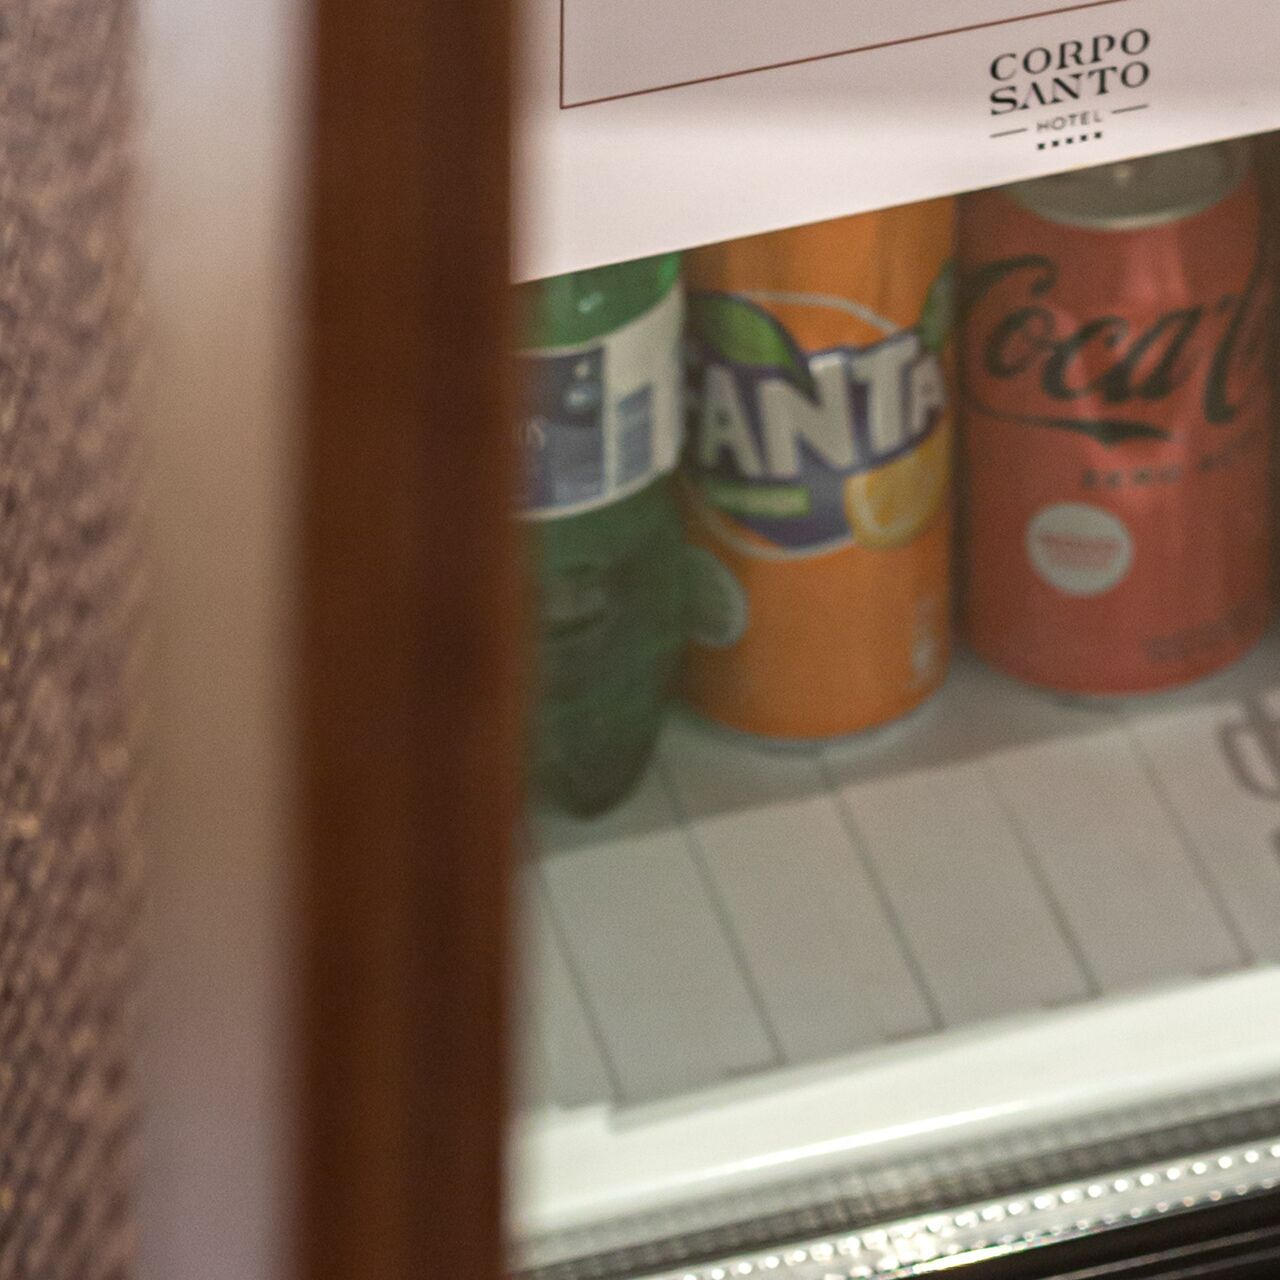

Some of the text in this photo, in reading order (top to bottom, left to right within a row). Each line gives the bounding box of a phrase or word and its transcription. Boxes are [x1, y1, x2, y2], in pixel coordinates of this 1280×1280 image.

[989, 28, 1150, 82] CORPO
[989, 61, 1150, 116] SANTO
[1036, 111, 1104, 133] HOTEL
[701, 334, 947, 480] ANTA
